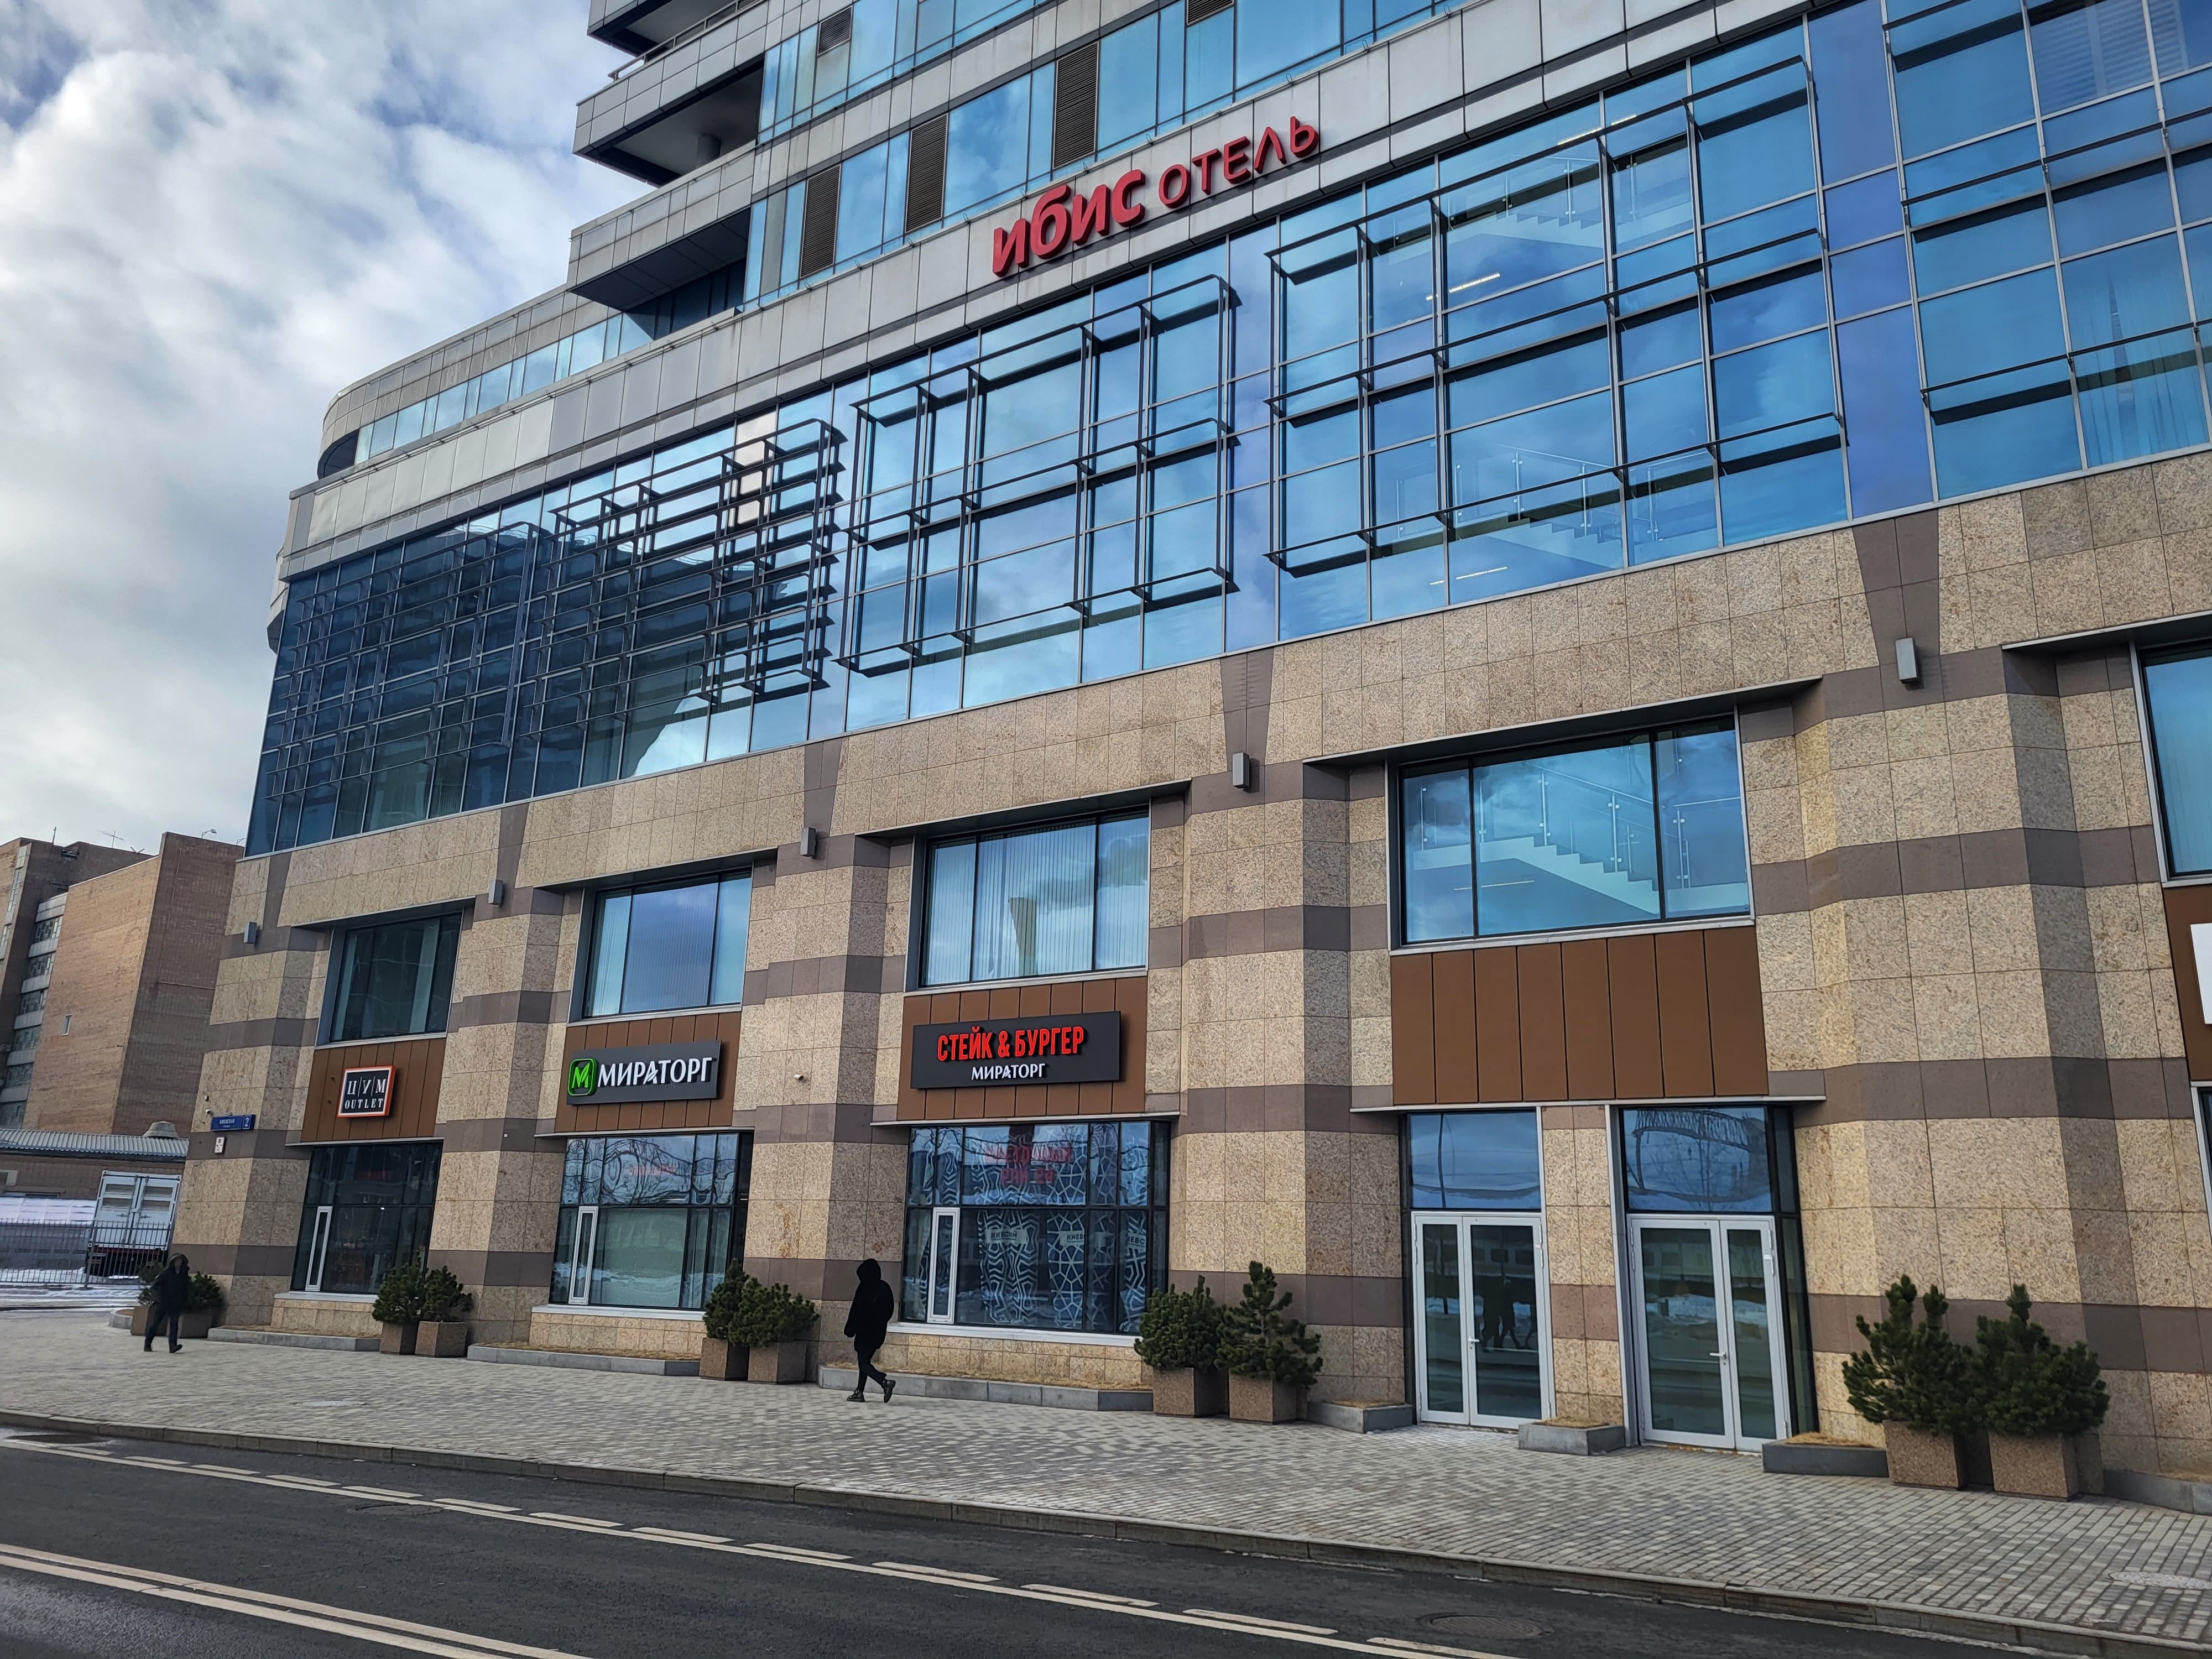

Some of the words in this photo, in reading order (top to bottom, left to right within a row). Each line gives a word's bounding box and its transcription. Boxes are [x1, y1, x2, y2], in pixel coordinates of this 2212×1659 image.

[937, 1026, 993, 1062] СТЕЙК
[998, 1030, 1010, 1057] &
[1015, 1026, 1084, 1057] БУРГЕР
[597, 1057, 712, 1088] МИРАТОРГ
[971, 1063, 1046, 1081] МИРАТОРГ
[345, 1098, 384, 1109] OUTLET
[244, 1117, 249, 1127] 2
